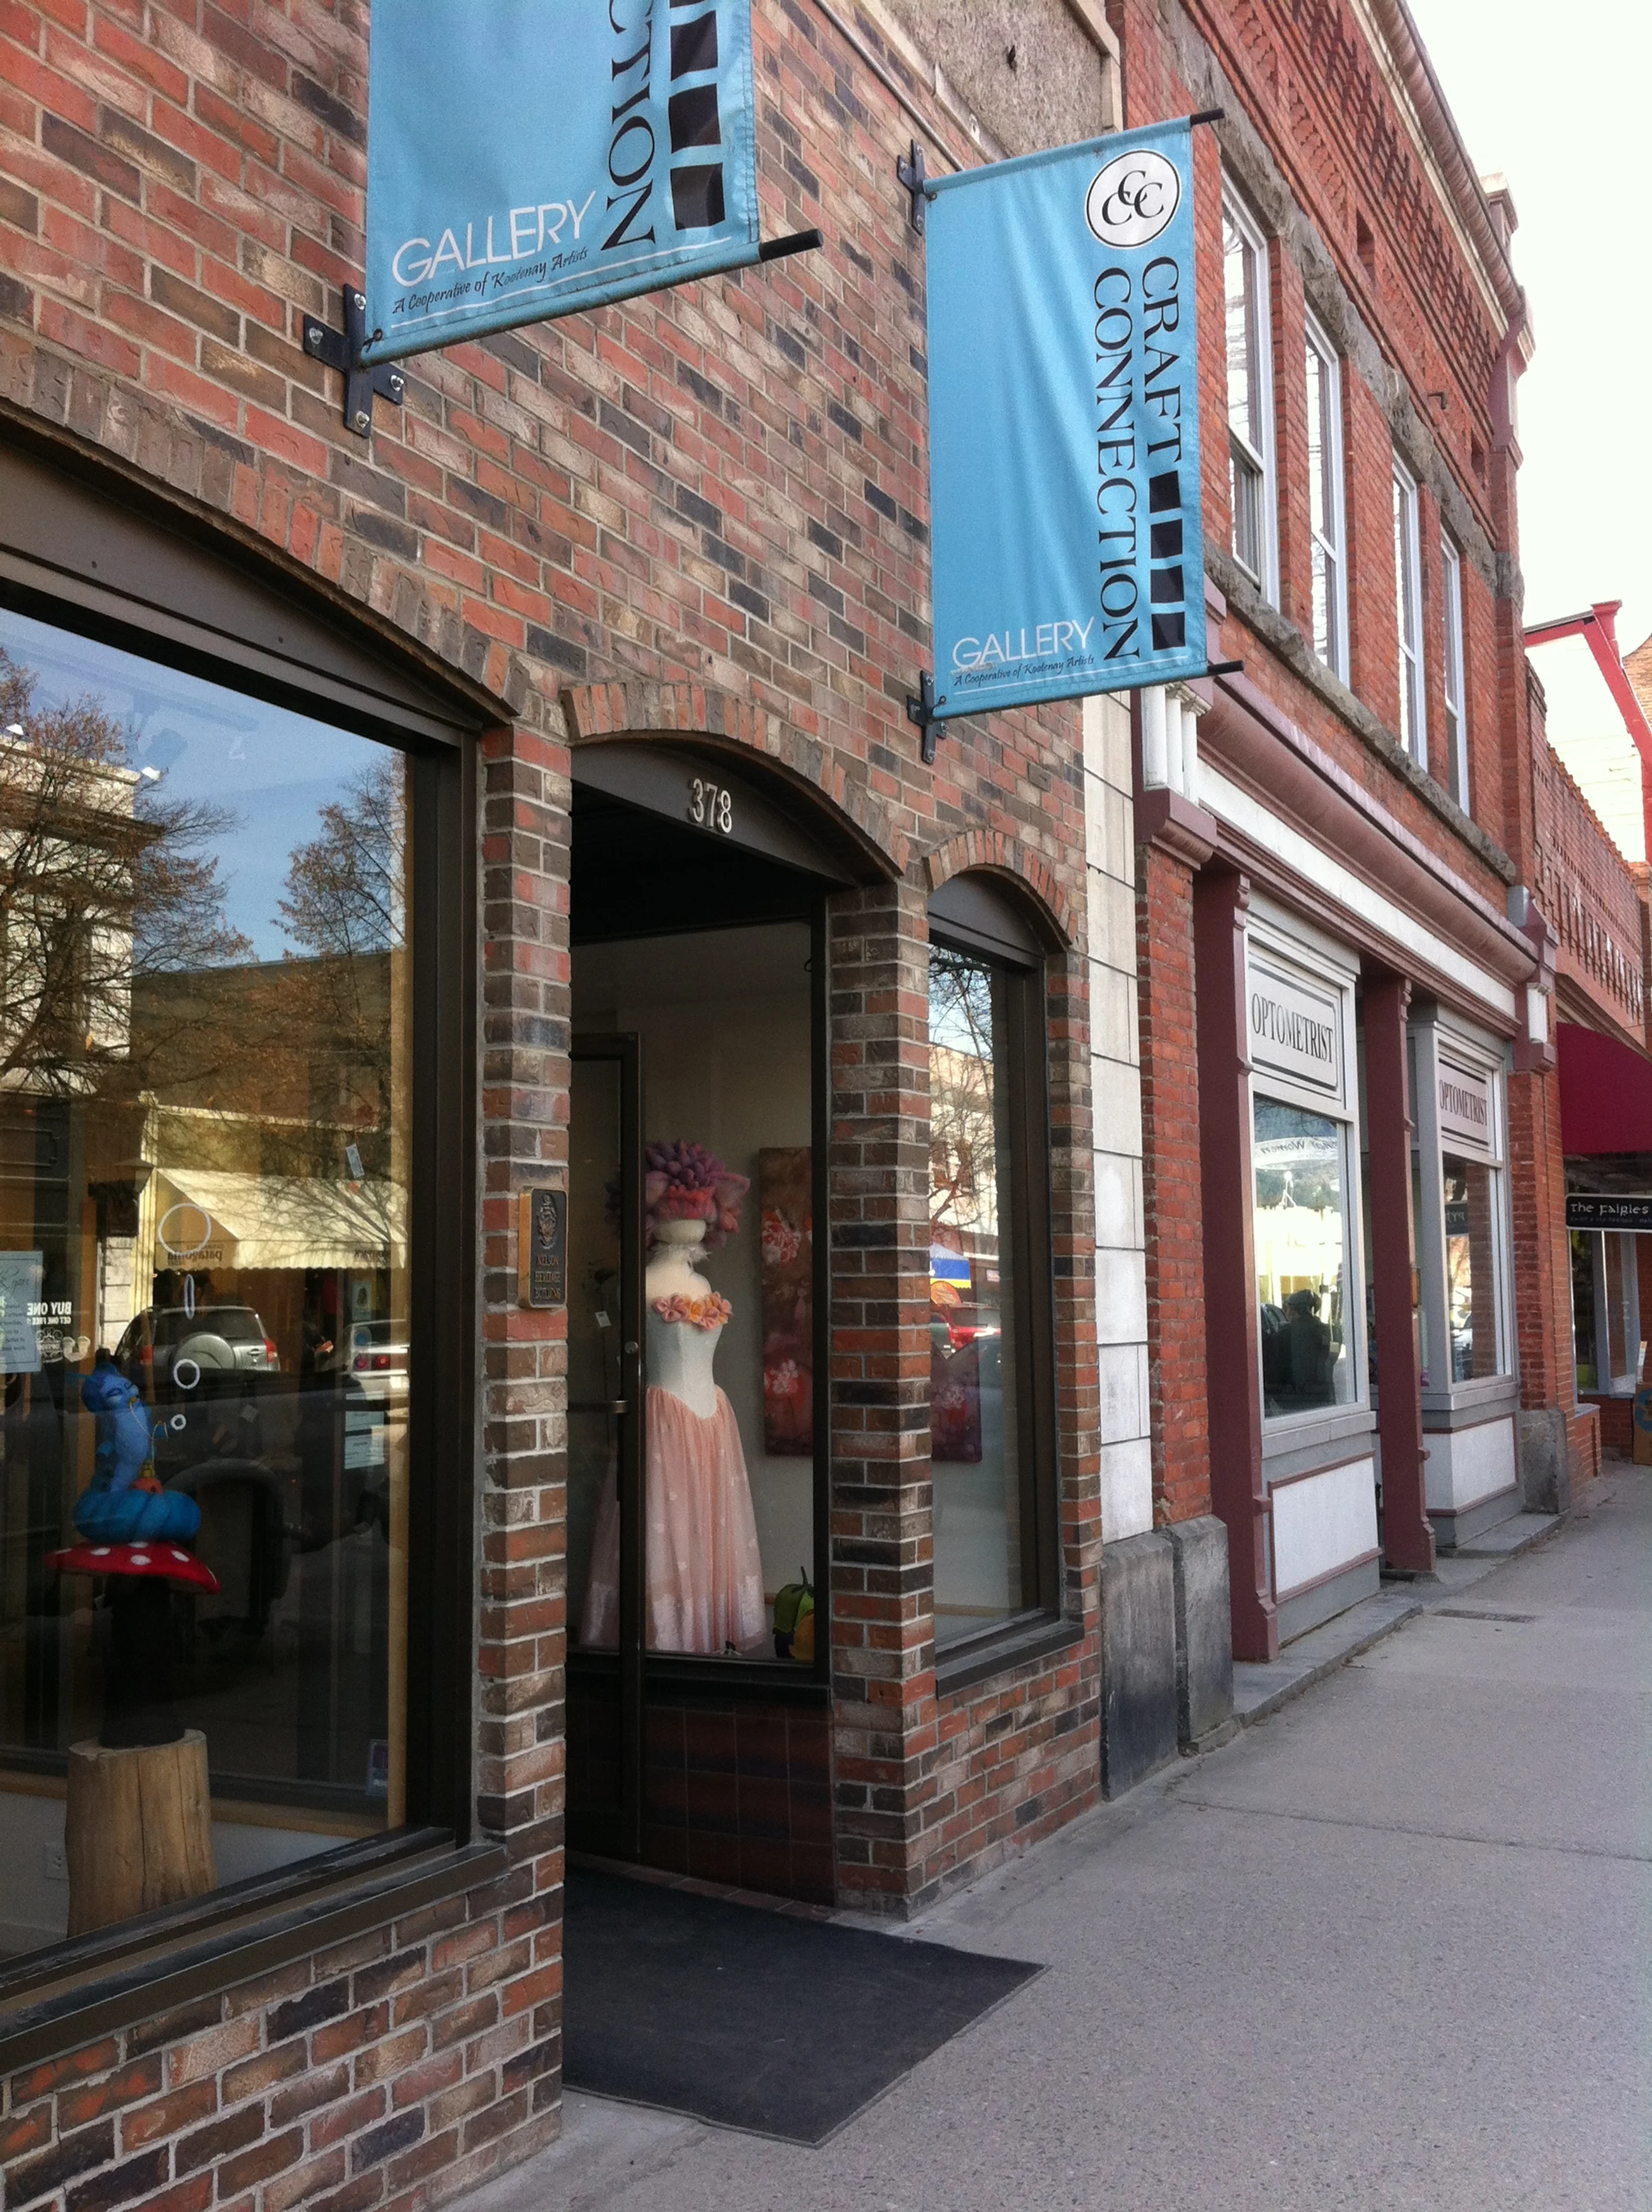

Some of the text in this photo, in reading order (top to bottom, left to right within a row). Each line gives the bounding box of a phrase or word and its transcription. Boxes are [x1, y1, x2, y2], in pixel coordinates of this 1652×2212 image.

[392, 190, 596, 287] GALLERY
[392, 246, 588, 314] A Cooperative of Kootenay Artists
[1142, 256, 1182, 463] CRAFT
[1094, 267, 1140, 661] CONNECTION
[952, 616, 1095, 670] GALLERY
[953, 654, 1095, 687] A Cooperative of Kootenay Artists
[690, 778, 733, 834] 378
[1252, 993, 1333, 1064] OPTOMETRIST
[1439, 1079, 1488, 1126] OPTOMETRIST
[1570, 1202, 1595, 1212] The
